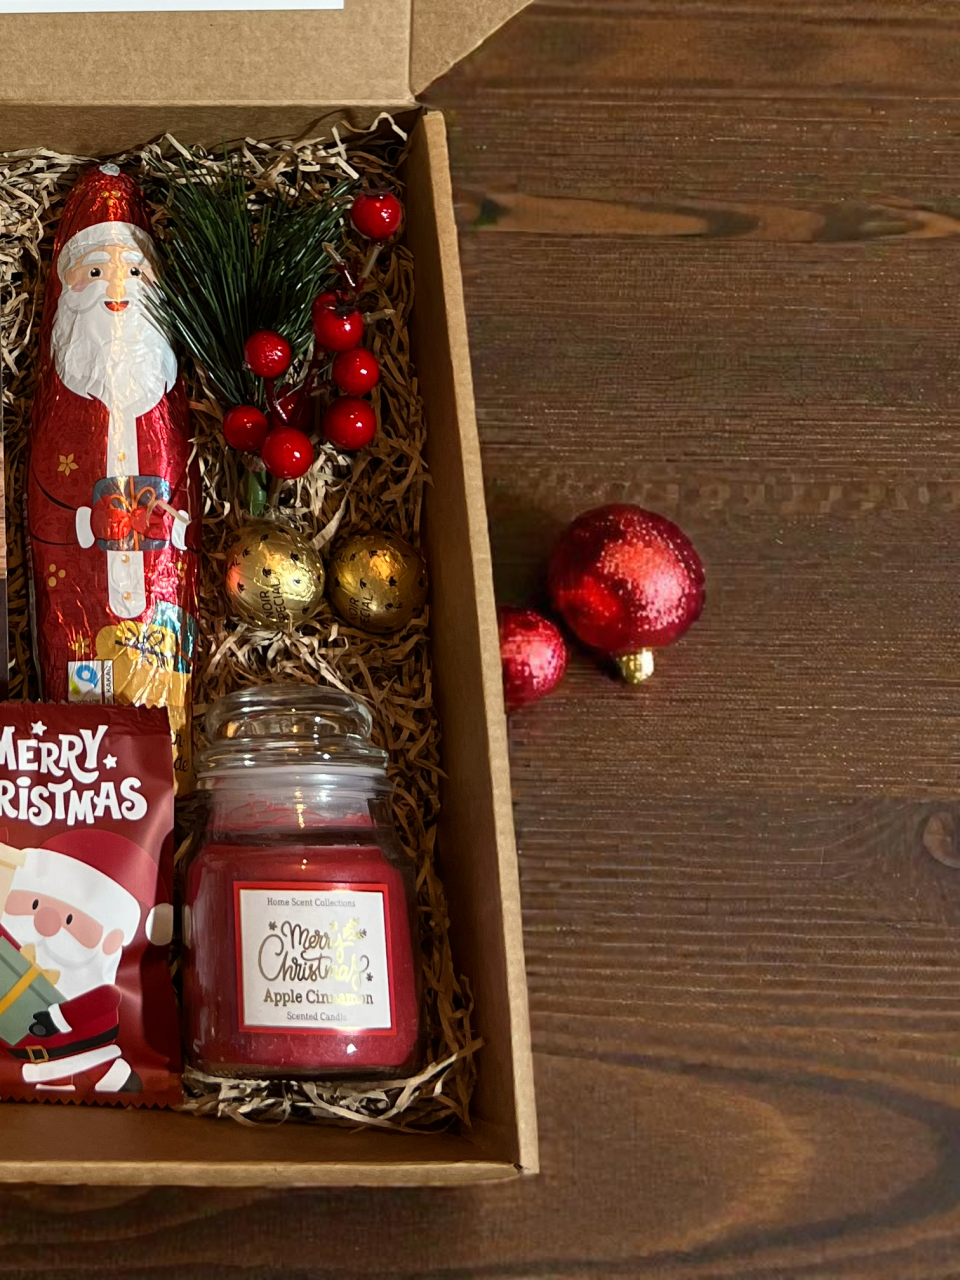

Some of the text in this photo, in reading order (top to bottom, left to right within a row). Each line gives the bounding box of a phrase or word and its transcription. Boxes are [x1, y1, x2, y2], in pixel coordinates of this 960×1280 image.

[359, 594, 374, 625] ECIAL
[267, 897, 356, 908] Home Scent Collections
[280, 920, 354, 963] Merry
[258, 934, 370, 991] Christmas
[263, 988, 303, 1007] Apple
[286, 1011, 347, 1022] Scented Candle
